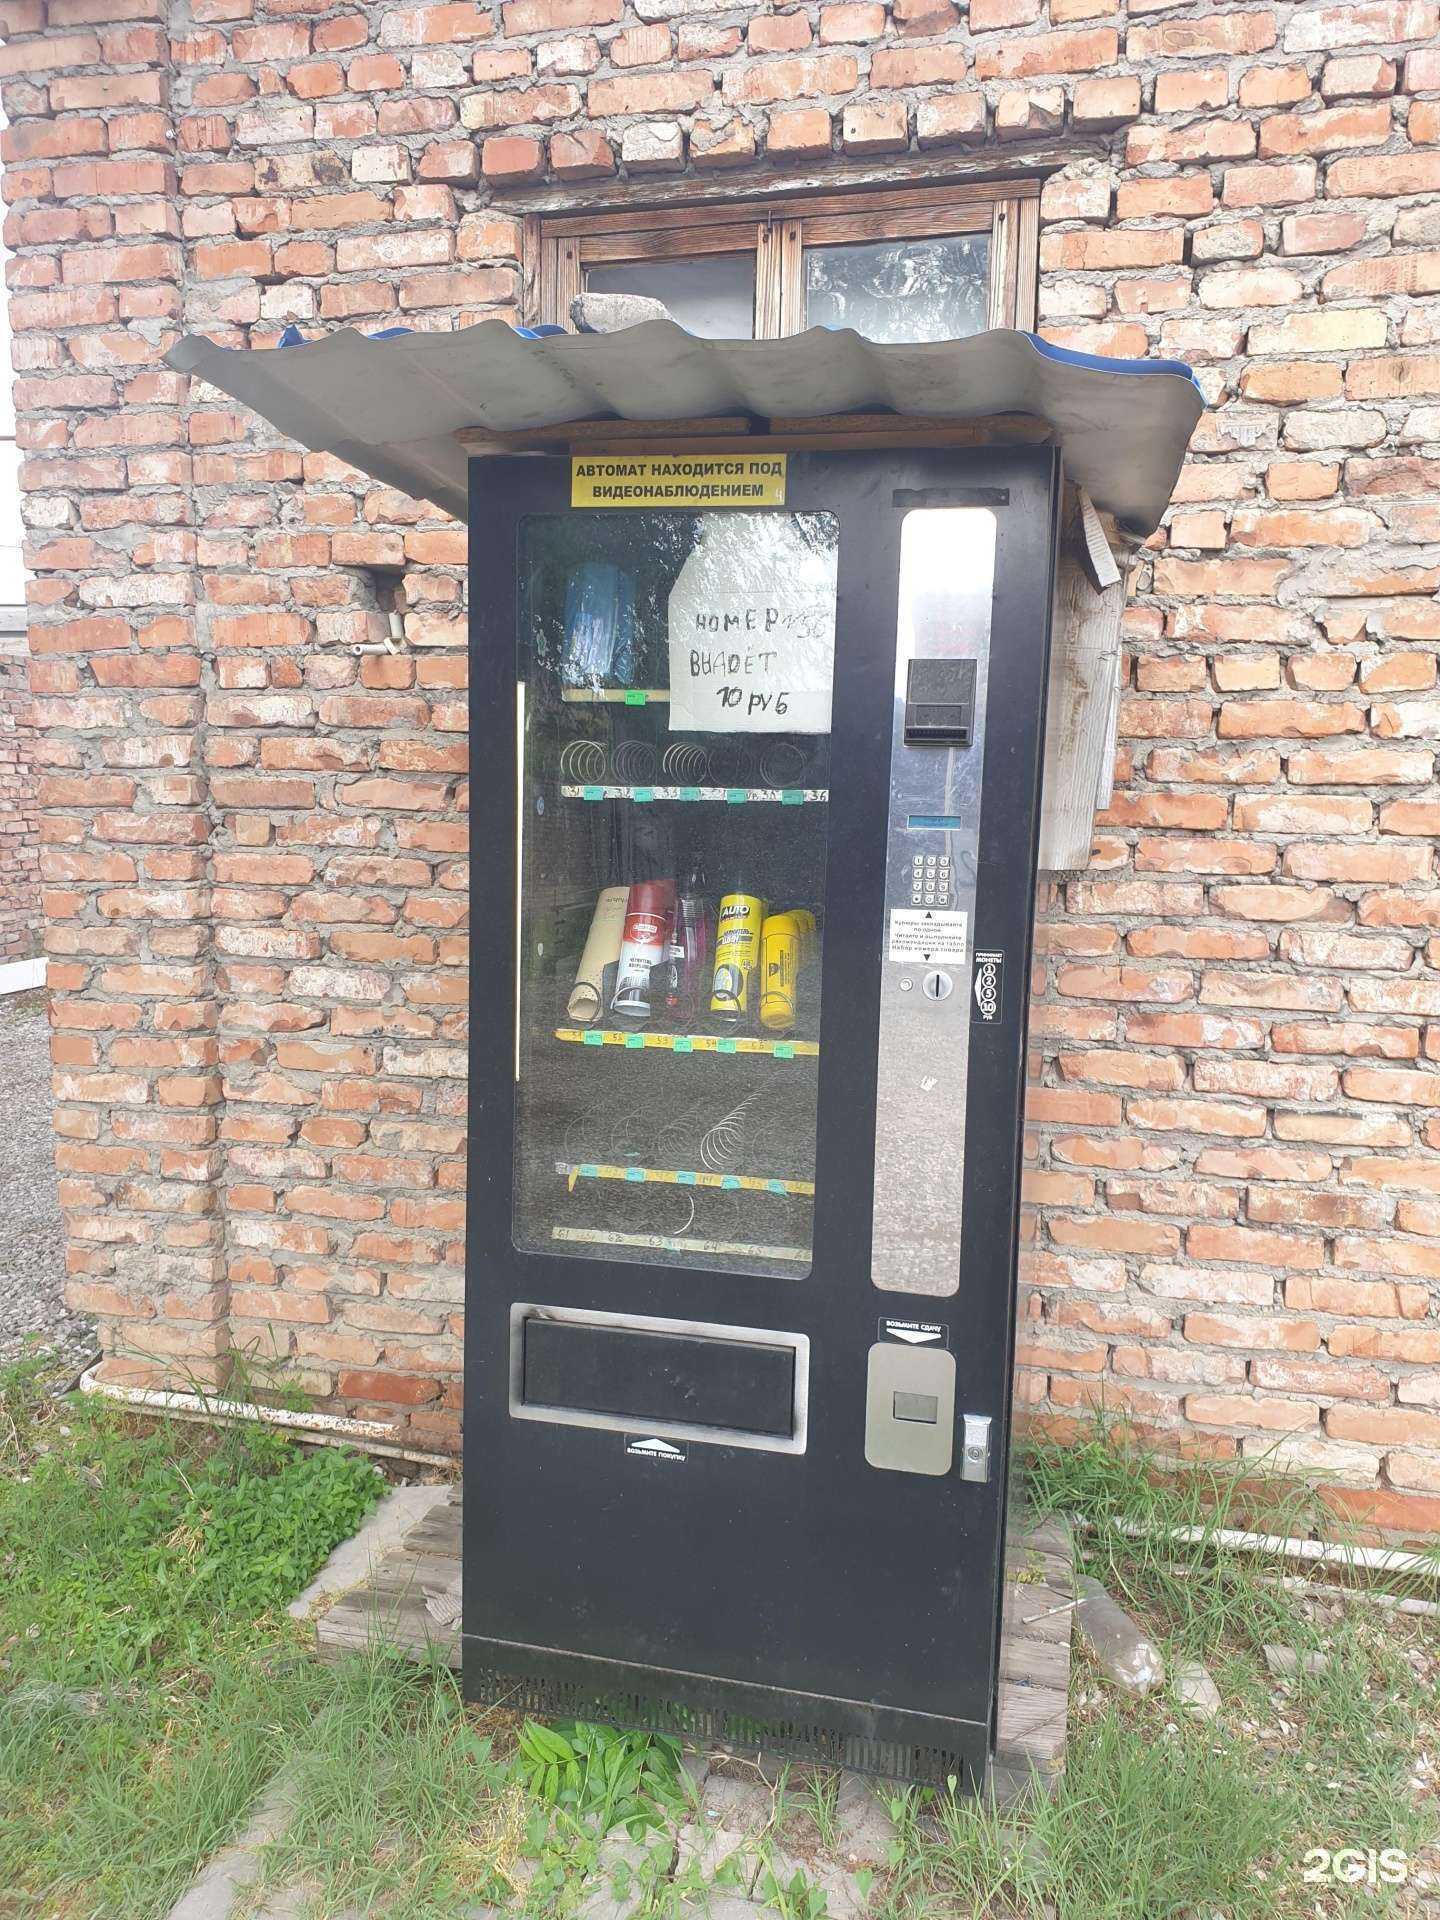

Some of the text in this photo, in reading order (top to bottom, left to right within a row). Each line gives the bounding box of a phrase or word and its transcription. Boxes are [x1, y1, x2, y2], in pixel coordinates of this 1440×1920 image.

[576, 461, 784, 479] АВТОМАТ НАХОДИТСЯ ПОД
[592, 483, 764, 499] ВИДЕОНАБЛЮДЕНИЕМ
[695, 607, 779, 633] НОМЕР
[716, 686, 742, 708] 10
[721, 905, 750, 917] AUTO
[886, 1320, 942, 1332] ВОЗЬМИТЕ СДАЧУ
[626, 1447, 658, 1457] ВОЗЬМИТЕ
